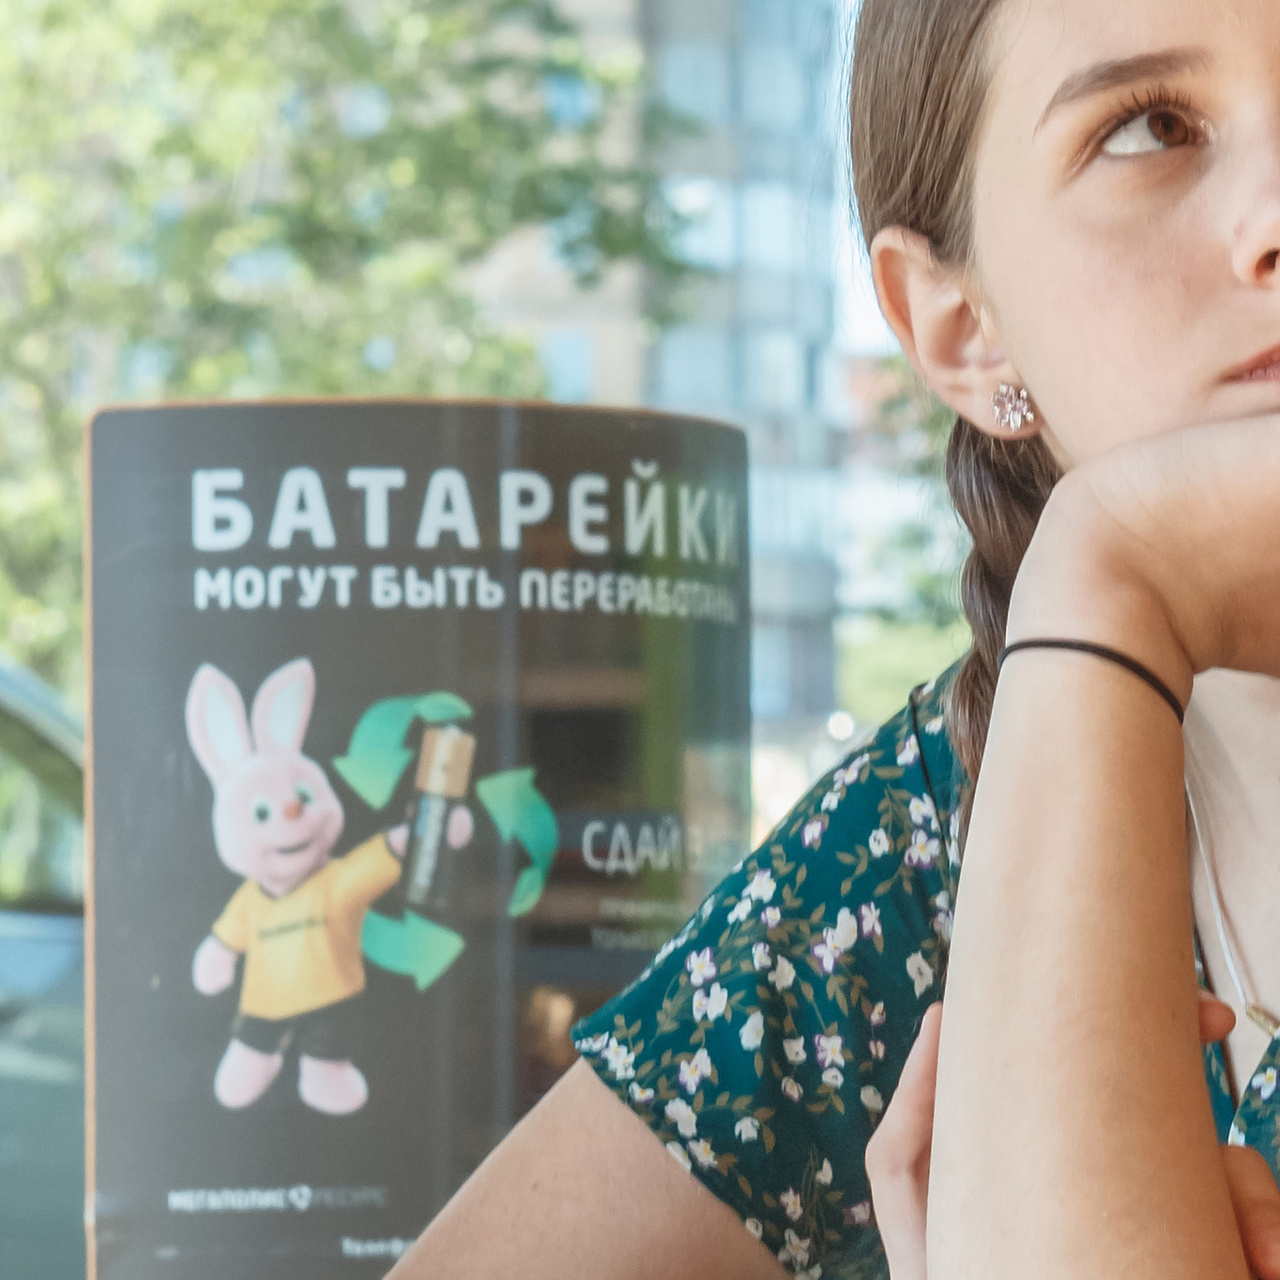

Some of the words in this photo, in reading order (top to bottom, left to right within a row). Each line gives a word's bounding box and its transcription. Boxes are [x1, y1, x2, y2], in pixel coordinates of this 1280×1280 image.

[190, 458, 738, 566] БАТАРЕЙКИ
[194, 566, 357, 610] МОГУТ
[371, 566, 505, 611] БЫТЬ
